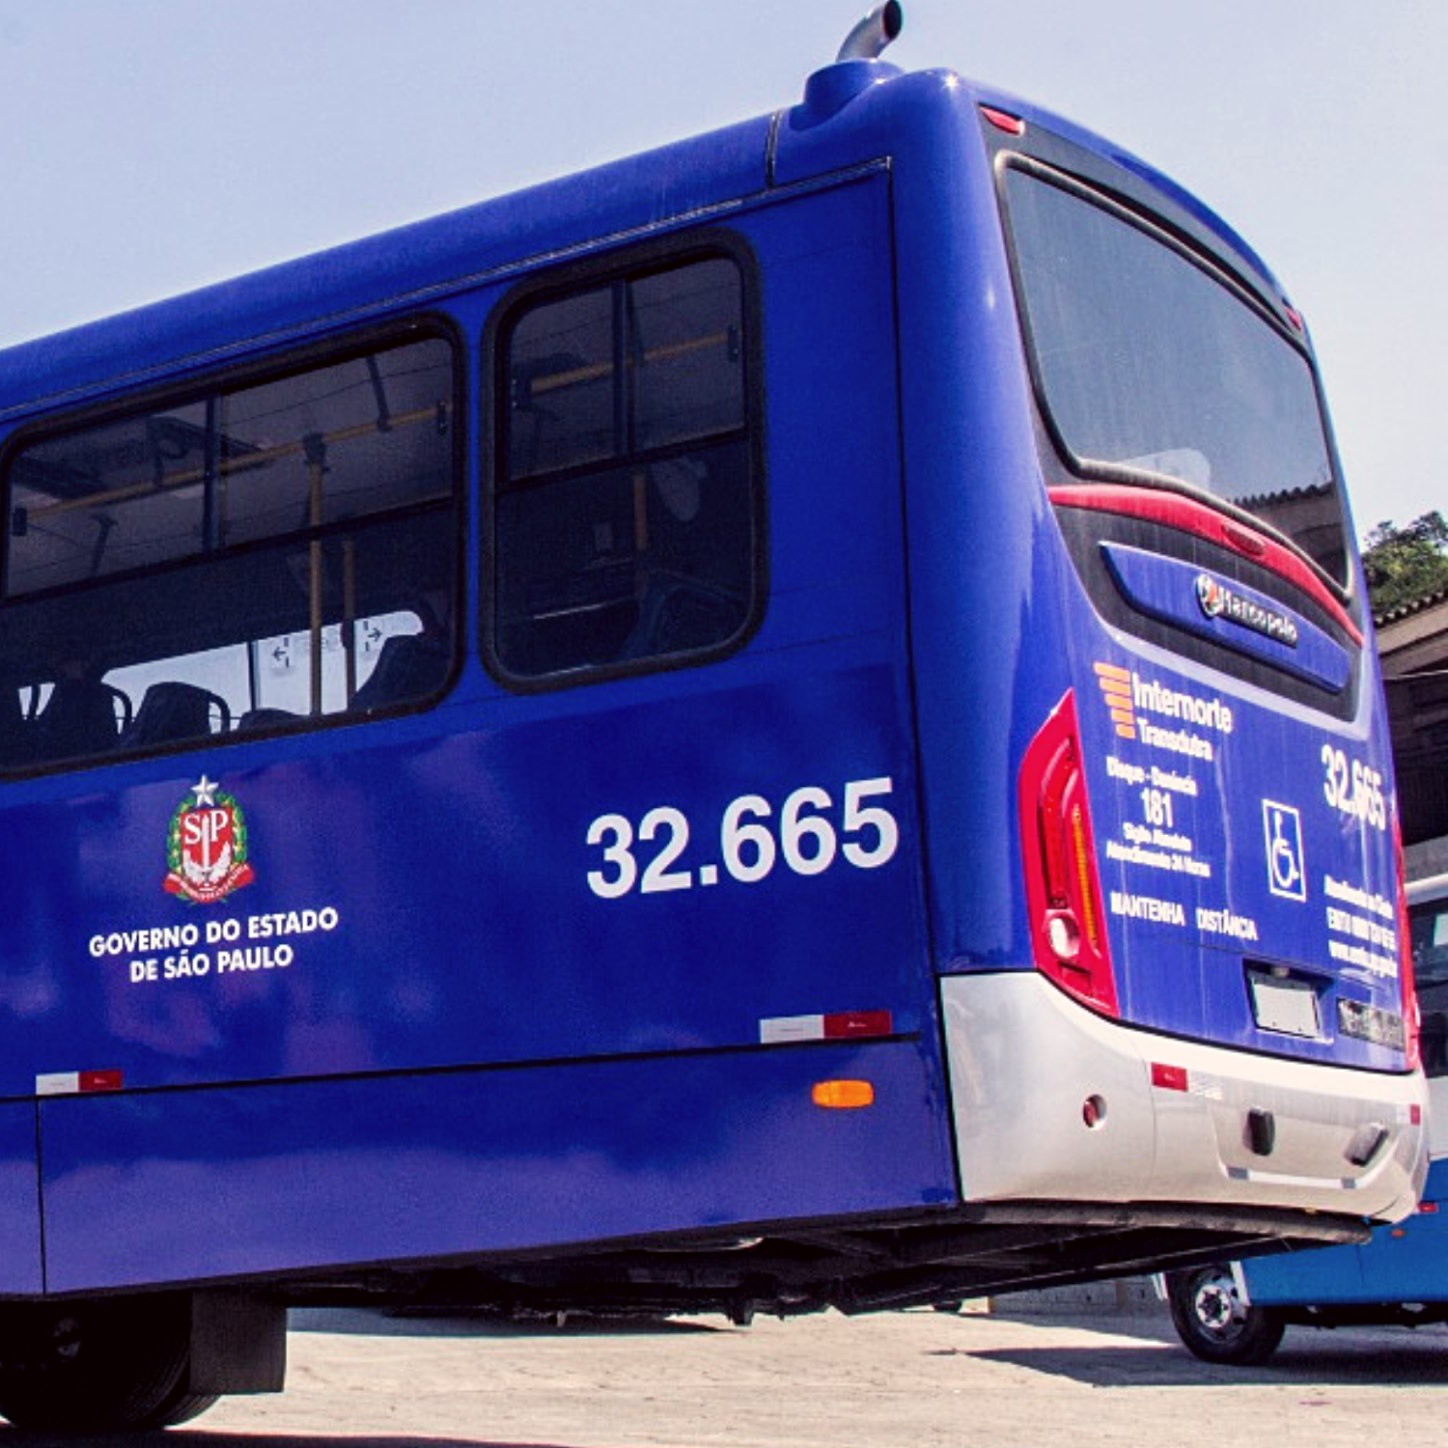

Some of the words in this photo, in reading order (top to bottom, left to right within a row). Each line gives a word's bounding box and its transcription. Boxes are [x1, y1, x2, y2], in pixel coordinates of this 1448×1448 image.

[1132, 672, 1232, 733] Internorte
[1136, 717, 1213, 761] Transdutra
[1140, 787, 1173, 828] 181
[1321, 744, 1386, 830] 32.665
[586, 777, 899, 899] 32.665
[89, 923, 199, 957] GOVERNO
[206, 919, 240, 943] DO
[248, 907, 339, 938] ESTADO
[1110, 891, 1186, 926] MANTENHA
[1196, 906, 1259, 941] DISTÂNCIA
[130, 959, 158, 982] DE
[164, 949, 210, 979] SÃO
[217, 944, 294, 973] PAULO
